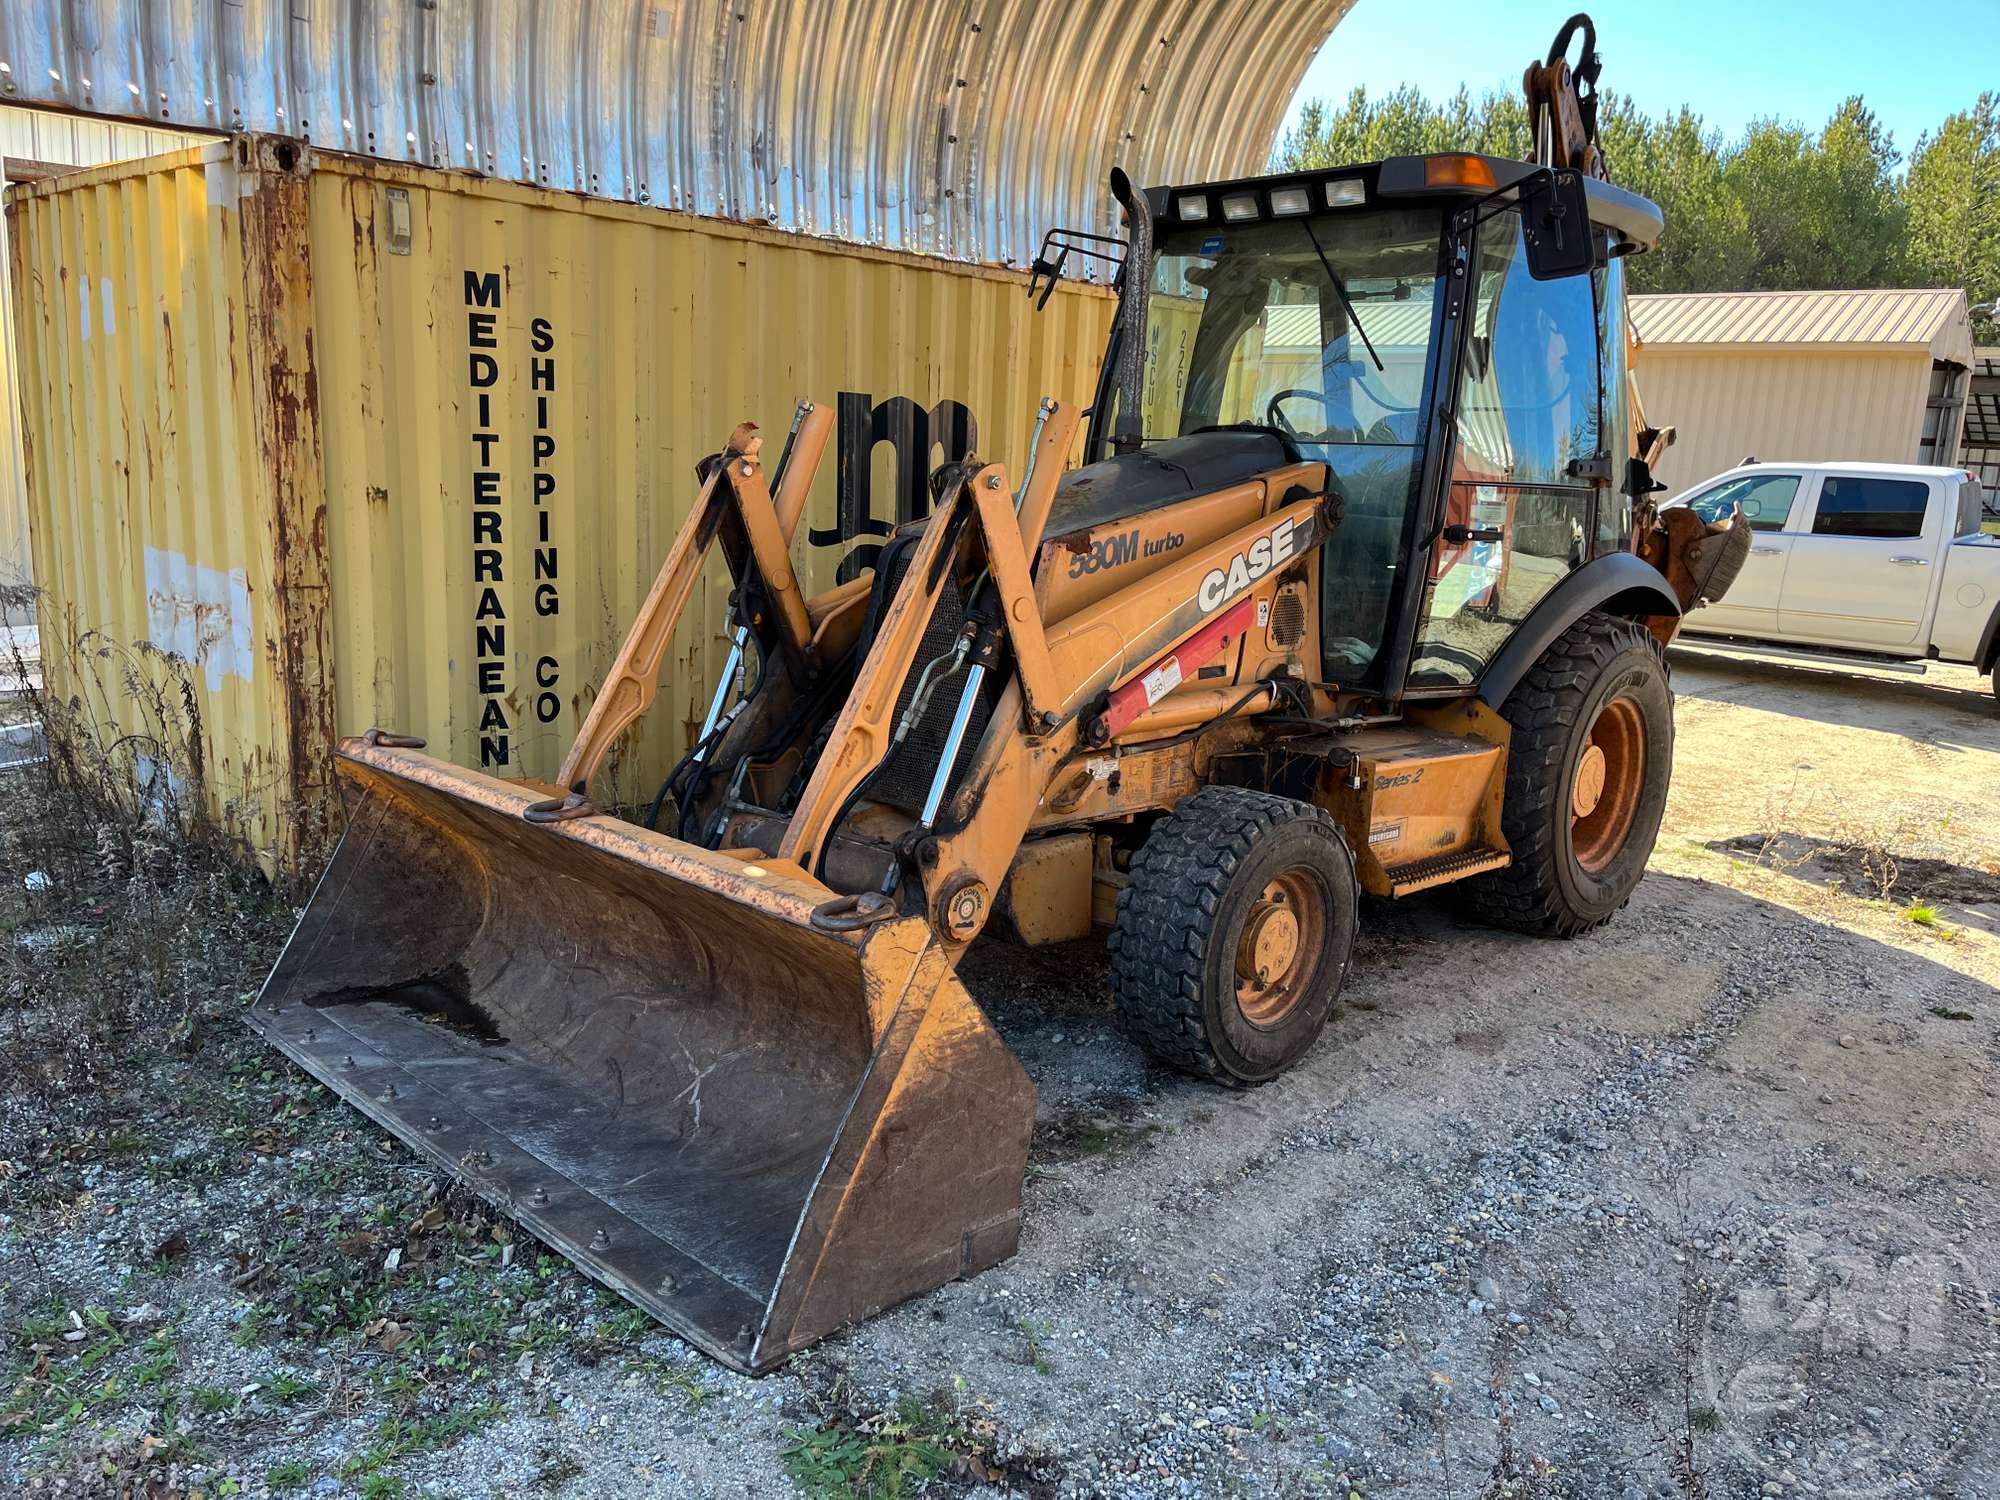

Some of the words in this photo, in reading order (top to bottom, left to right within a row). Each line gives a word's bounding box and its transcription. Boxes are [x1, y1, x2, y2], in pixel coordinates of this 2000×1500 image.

[1147, 324, 1160, 407] MSCU
[1175, 329, 1187, 409] 22G1
[530, 317, 559, 617] SHIPPING
[463, 270, 510, 768] MEDITERRANEAN
[1068, 530, 1139, 579] 580M
[1144, 531, 1184, 557] turbo
[1197, 516, 1295, 613] CASE
[535, 655, 561, 723] CO
[1375, 774, 1411, 791] Series
[1411, 767, 1425, 784] 2
